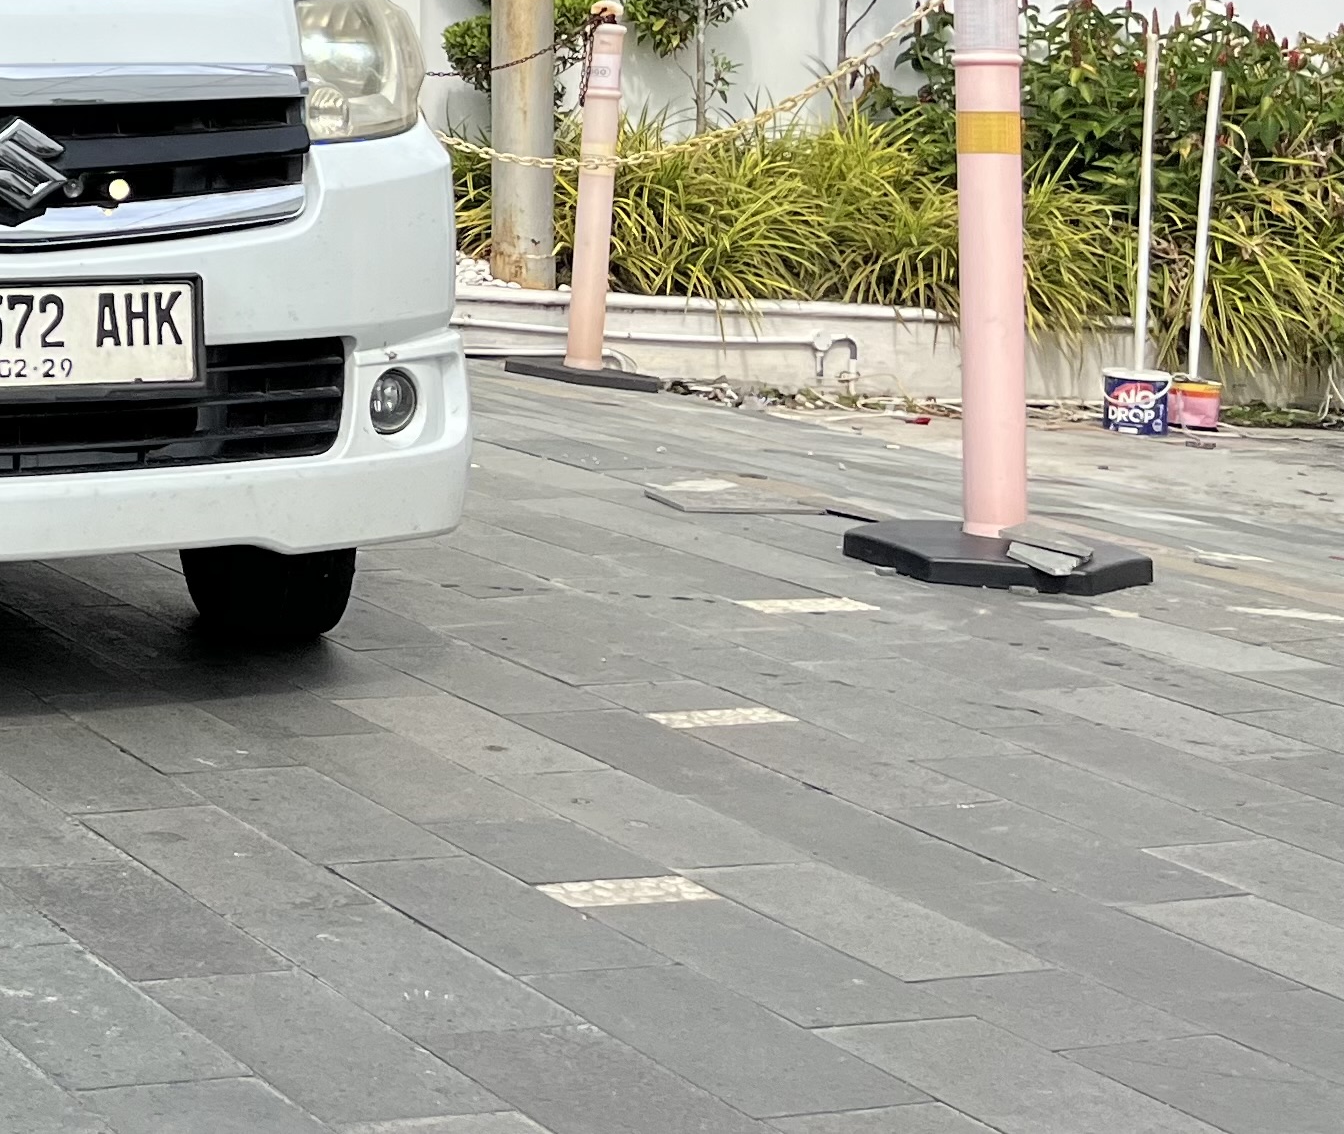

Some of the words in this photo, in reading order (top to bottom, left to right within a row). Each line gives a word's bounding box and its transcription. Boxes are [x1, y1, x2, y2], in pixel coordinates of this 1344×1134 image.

[95, 290, 184, 348] AHK
[1118, 387, 1156, 409] NO
[1108, 405, 1156, 423] DROP
